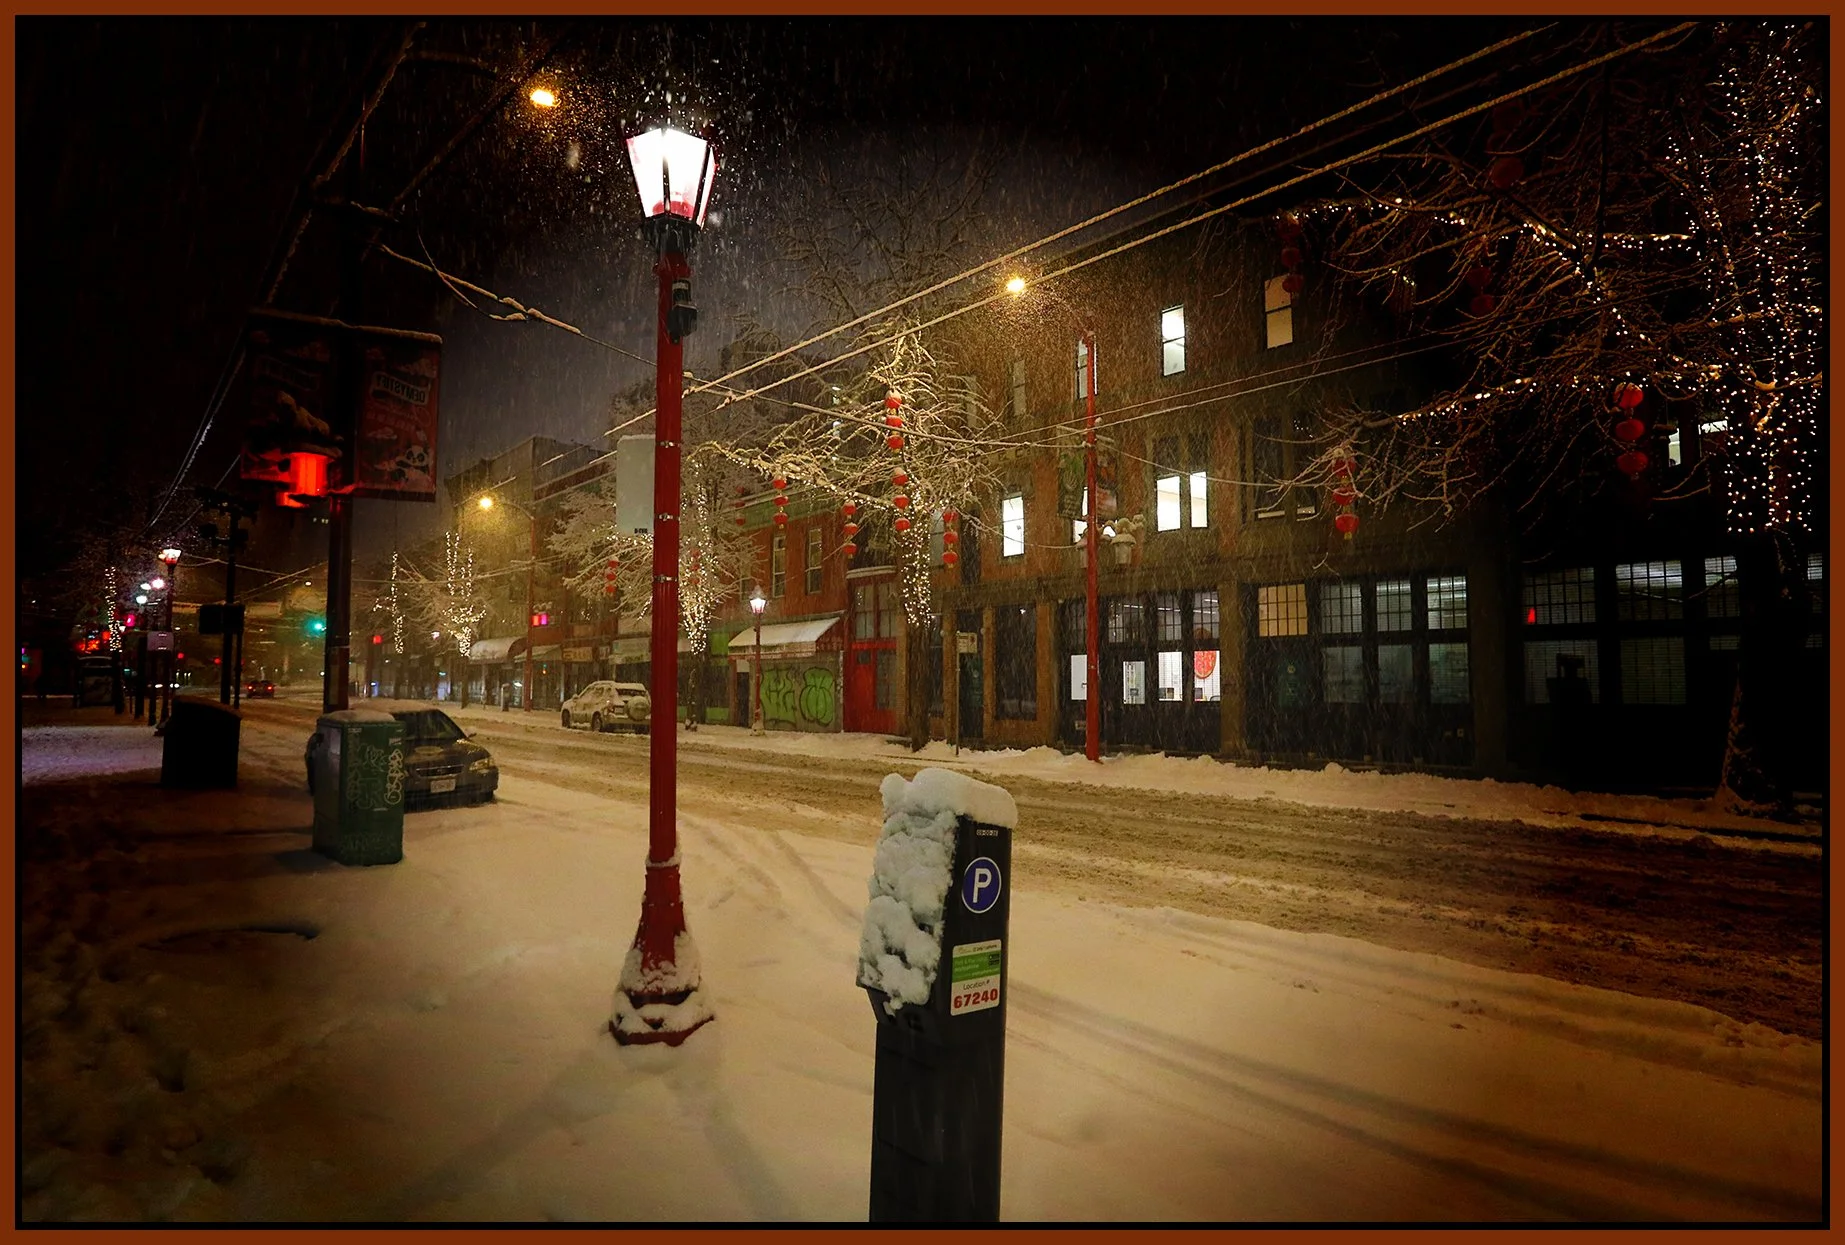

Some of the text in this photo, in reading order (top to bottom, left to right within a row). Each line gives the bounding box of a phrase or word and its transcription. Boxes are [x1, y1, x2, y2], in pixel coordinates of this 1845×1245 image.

[972, 867, 993, 904] P
[963, 981, 986, 991] Location
[953, 988, 998, 1009] 67240
